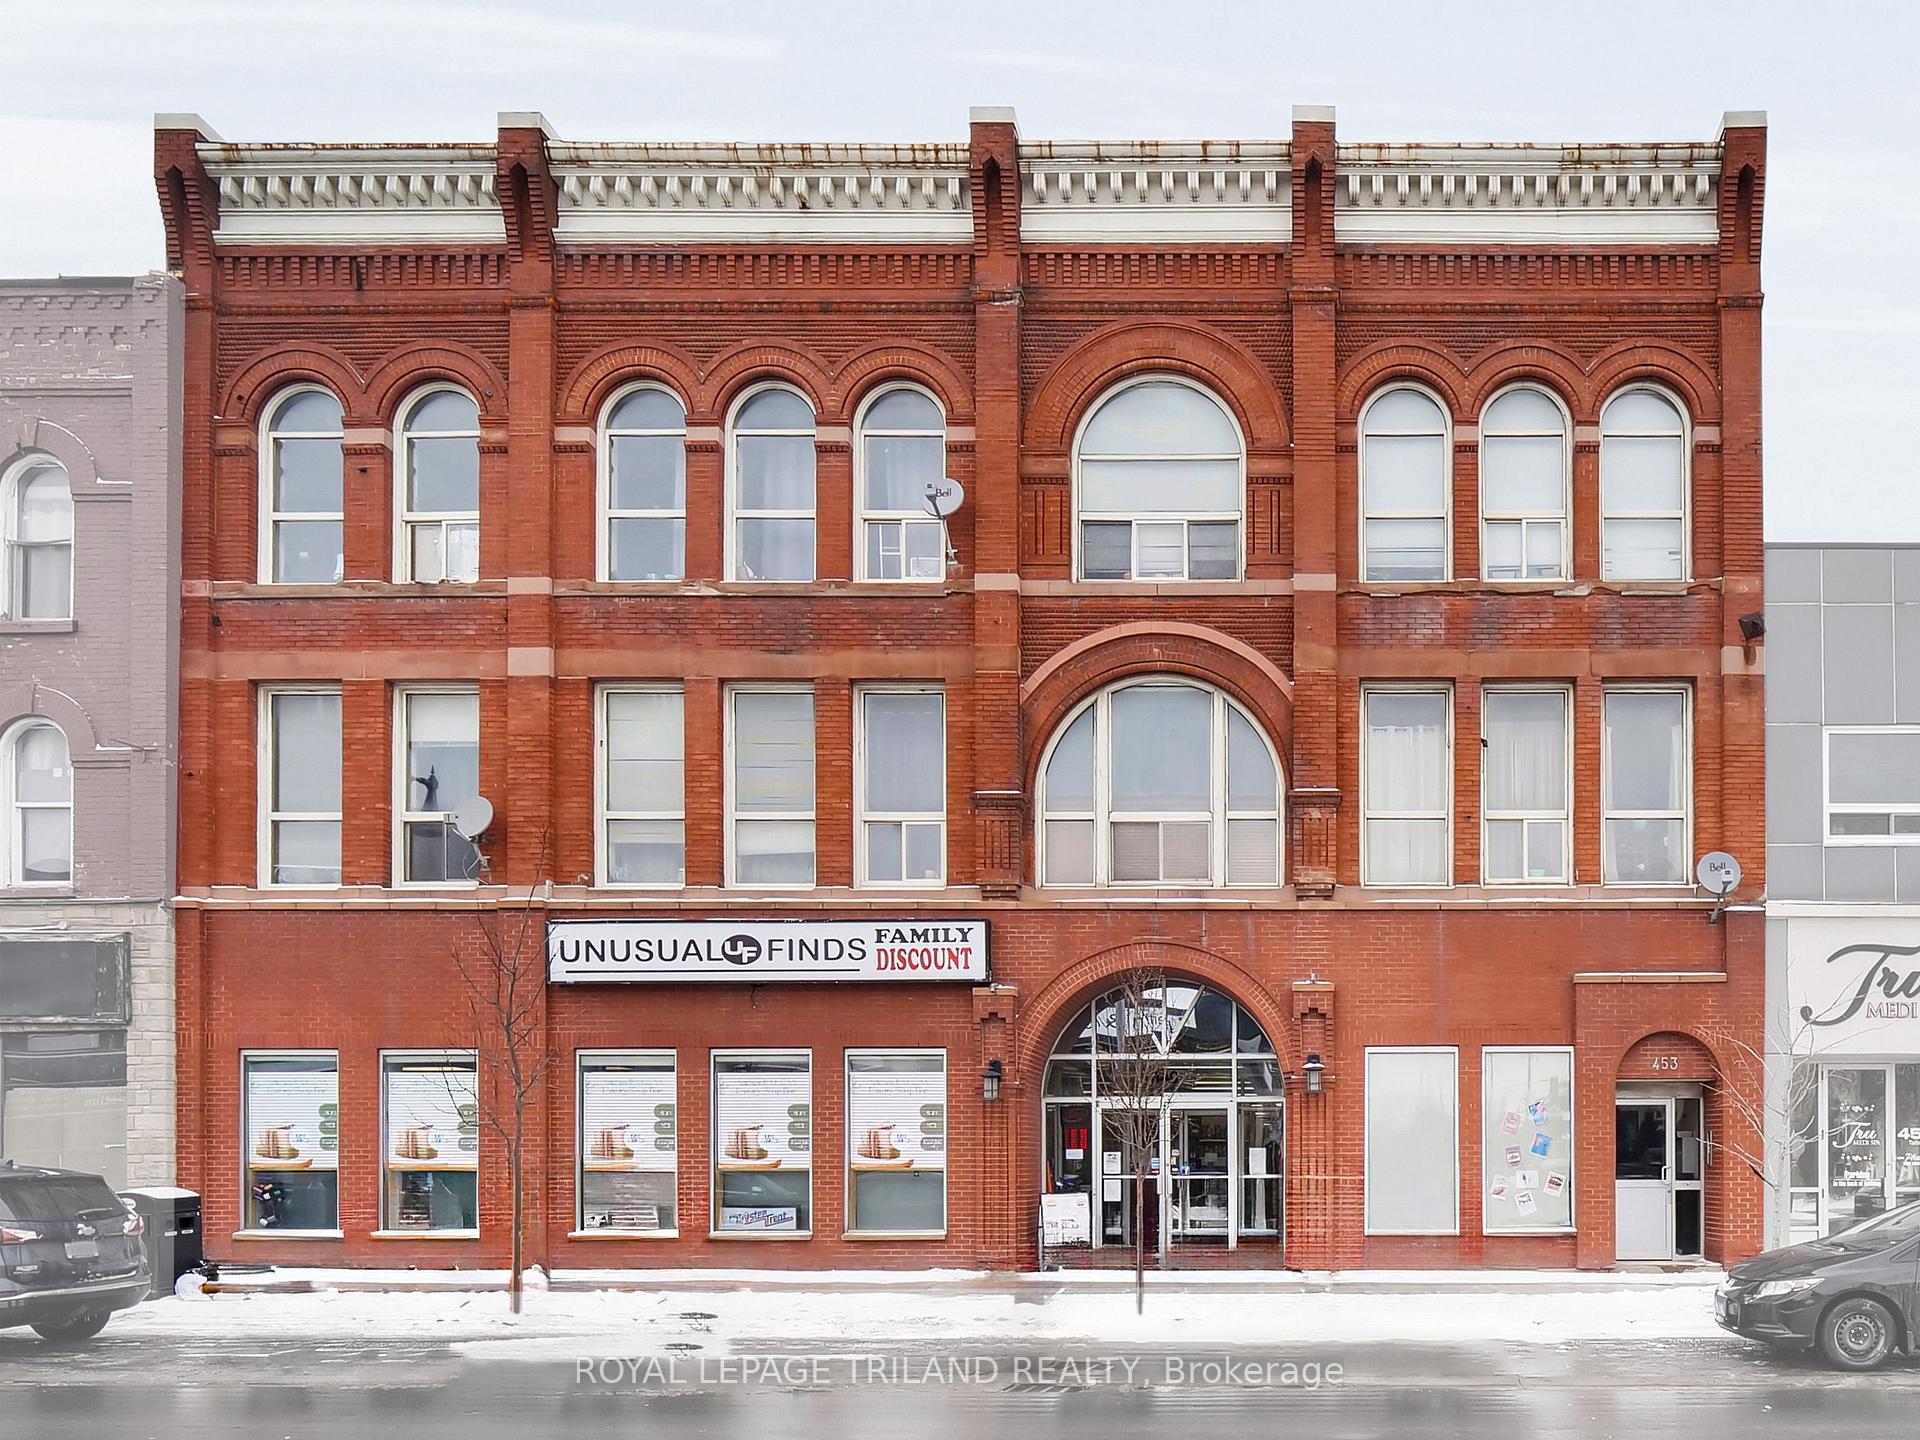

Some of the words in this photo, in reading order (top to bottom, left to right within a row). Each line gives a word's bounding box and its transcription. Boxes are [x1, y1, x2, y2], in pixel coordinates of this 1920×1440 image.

[935, 488, 952, 497] Bell
[1709, 862, 1726, 872] Bell
[874, 927, 974, 944] FAMILY
[559, 938, 724, 963] UNUSUAL
[767, 937, 867, 962] FINDS
[875, 946, 973, 971] DISCOUNT
[1865, 1001, 1918, 1019] MEDI
[1651, 1056, 1679, 1071] 453
[1832, 1121, 1878, 1149] Tru
